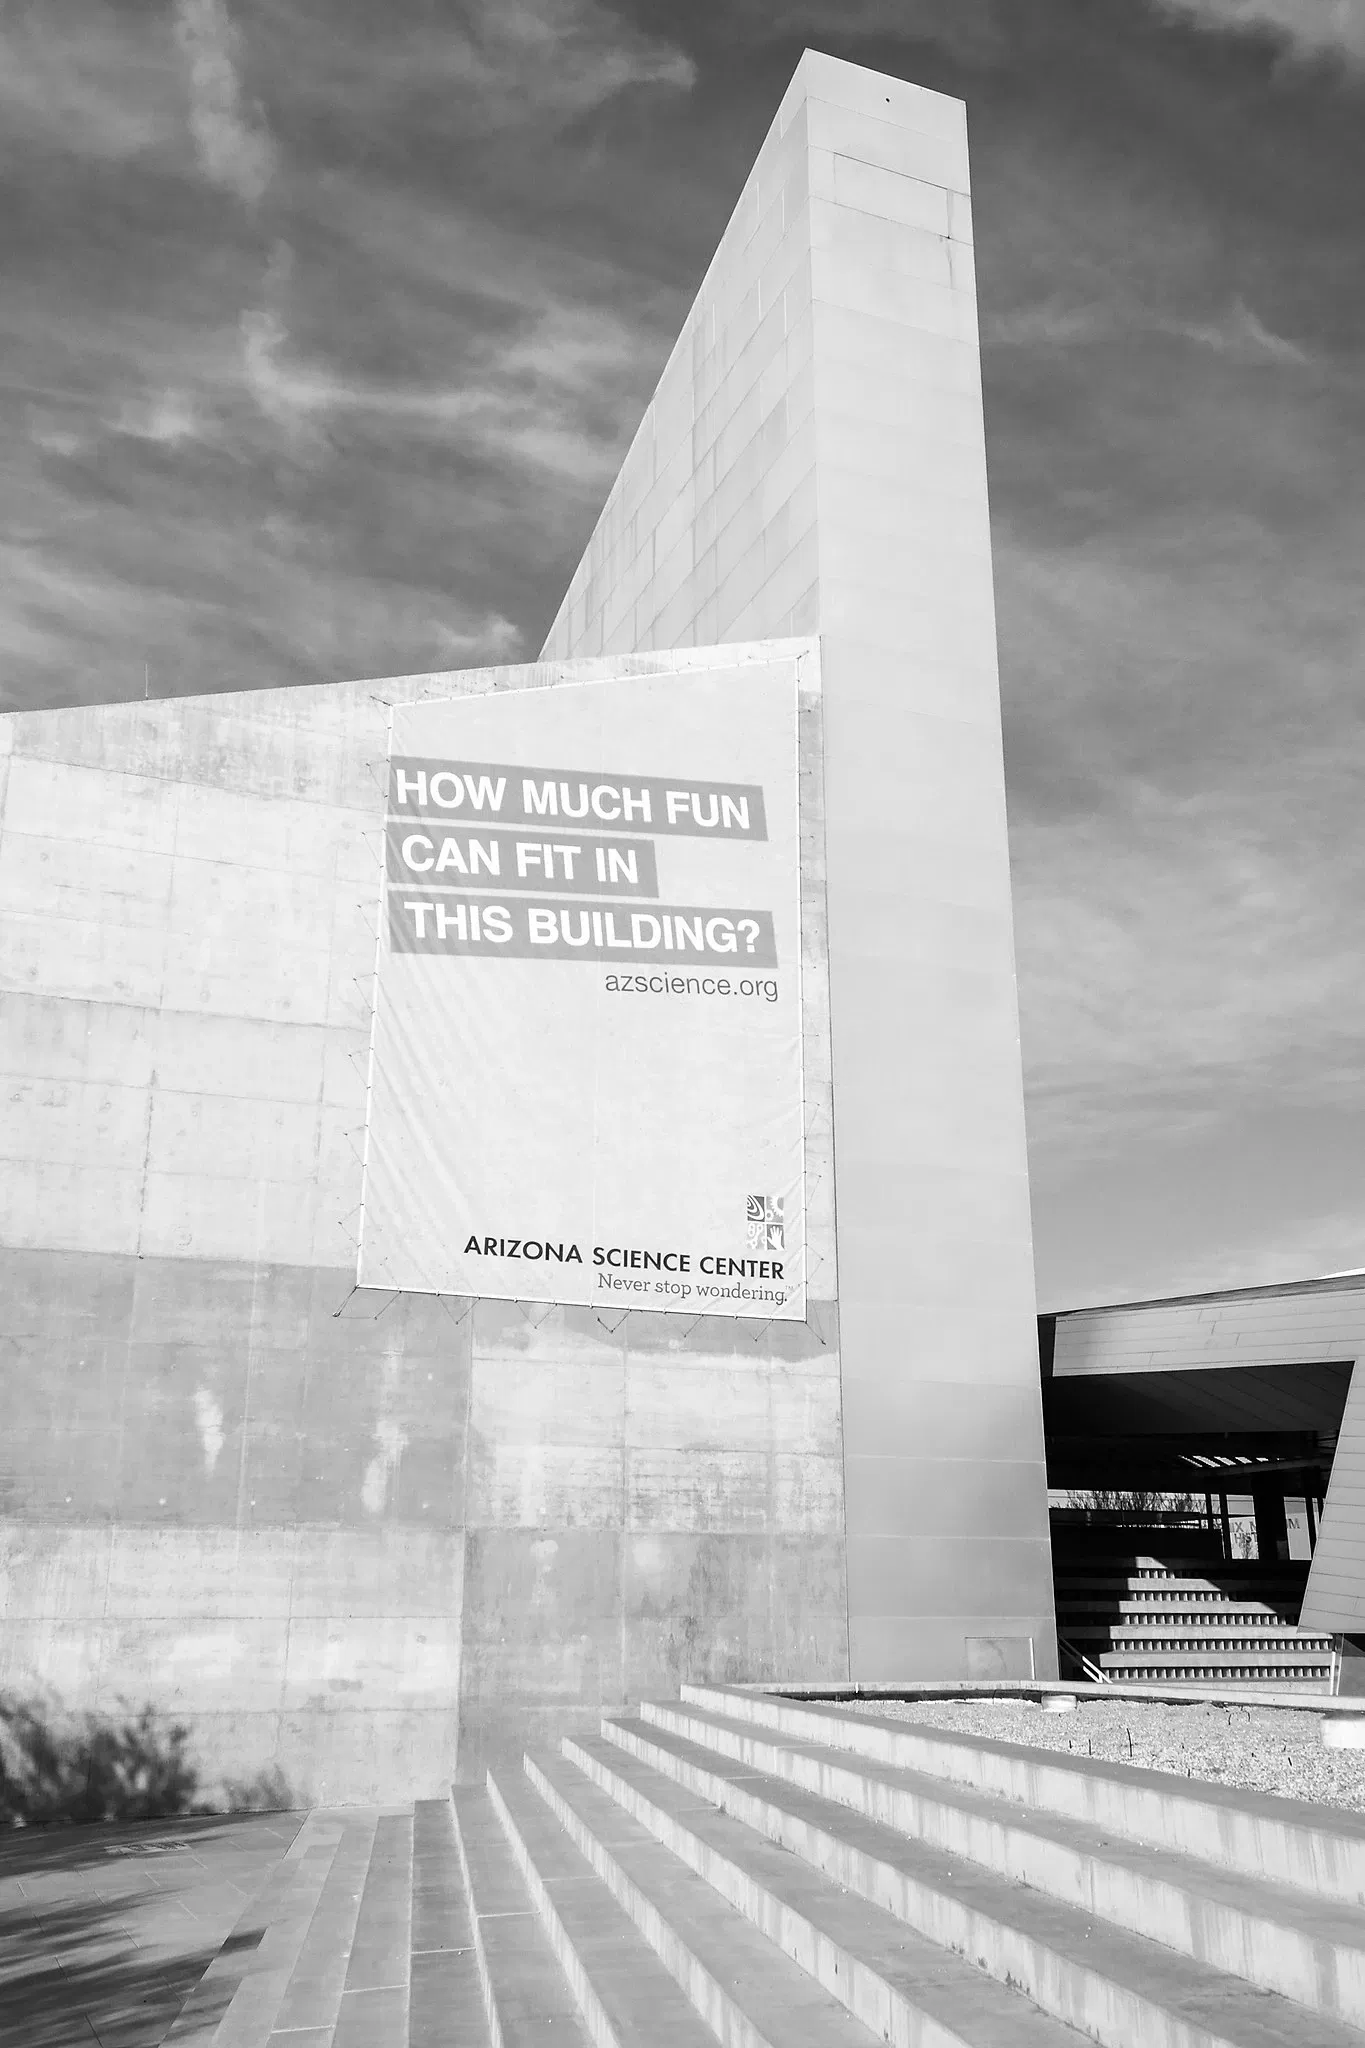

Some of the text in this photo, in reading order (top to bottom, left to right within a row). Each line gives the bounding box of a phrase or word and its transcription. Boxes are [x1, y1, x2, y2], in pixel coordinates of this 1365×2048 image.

[396, 769, 749, 830] HOW MUCH FUN
[402, 834, 639, 884] CAN FIT IN
[404, 902, 760, 953] THIS BUILDING?
[604, 971, 779, 1002] azscience.org
[464, 1236, 785, 1280] ARIZONA SCIENCE CENTER
[598, 1273, 651, 1293] Never
[654, 1280, 692, 1299] stop
